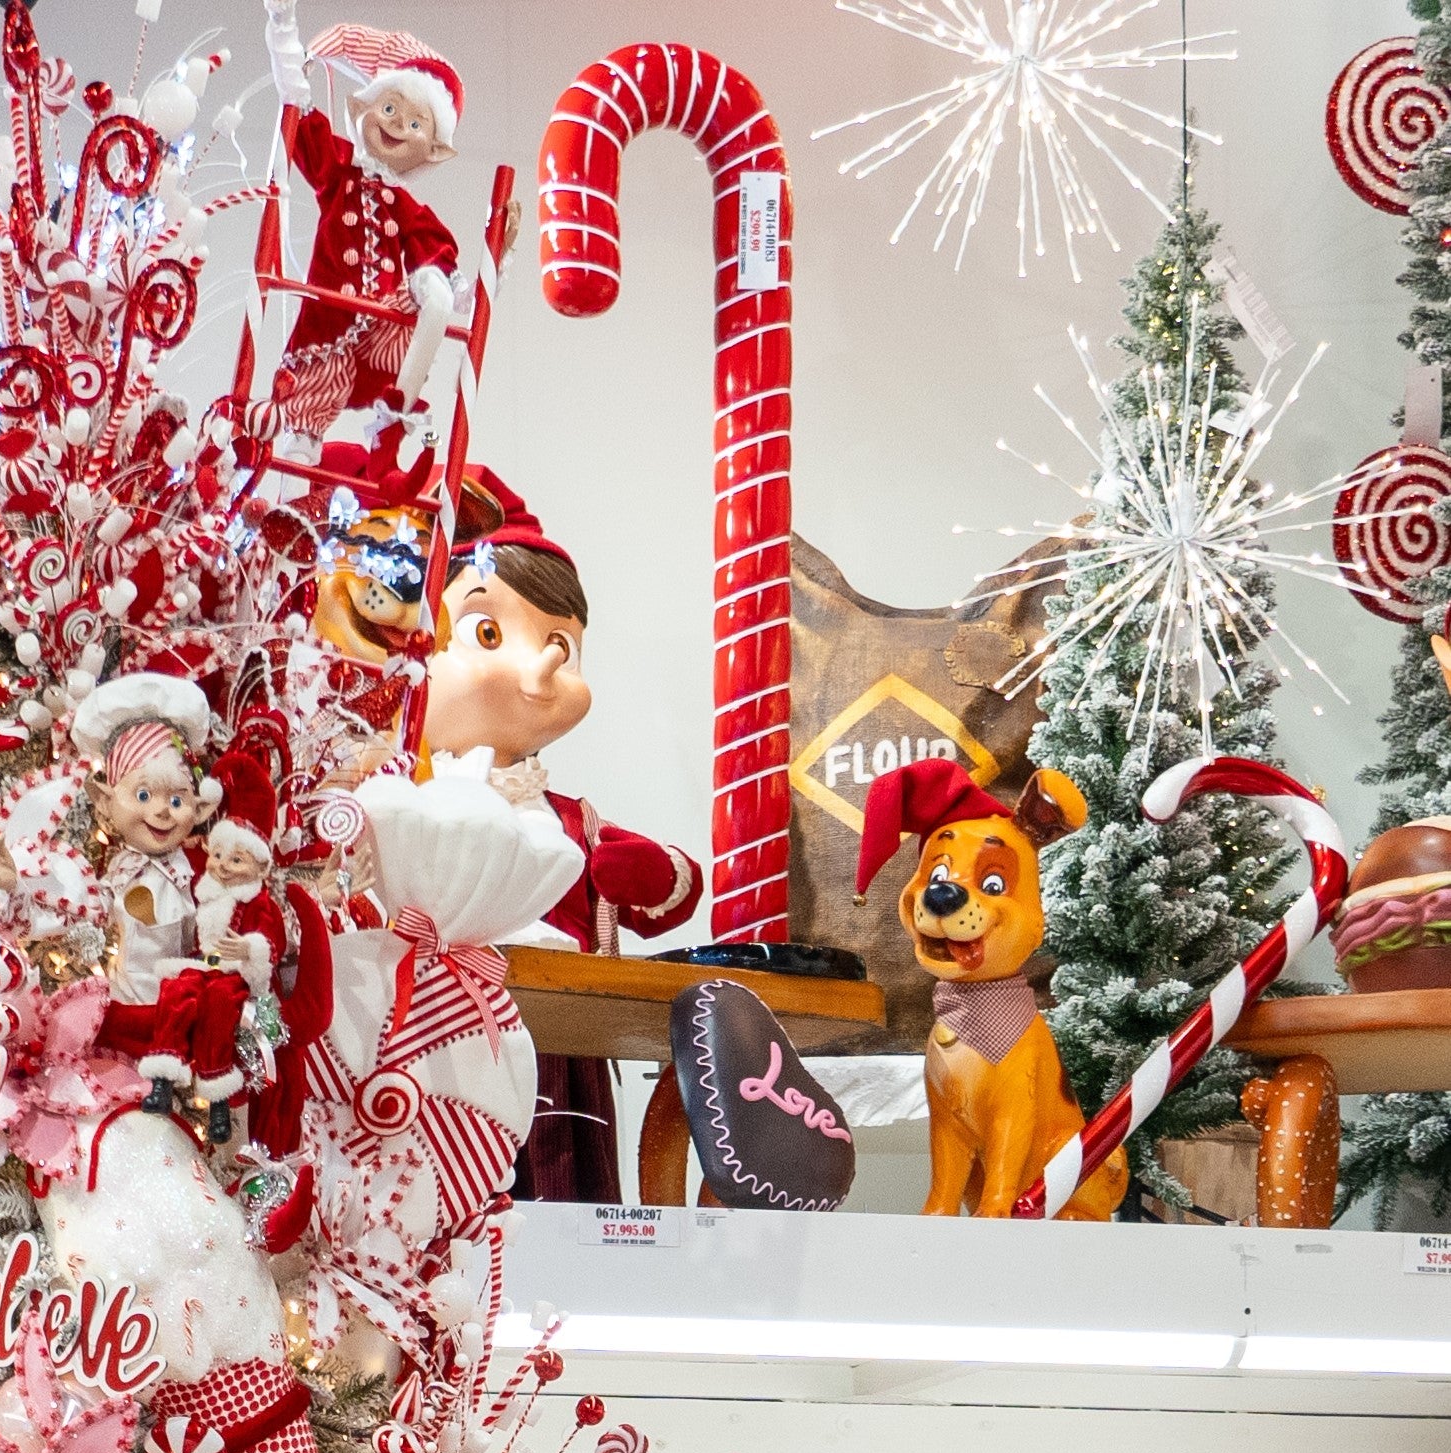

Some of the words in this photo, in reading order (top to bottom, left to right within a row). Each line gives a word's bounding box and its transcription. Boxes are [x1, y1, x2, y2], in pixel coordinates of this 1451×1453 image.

[750, 209, 761, 252] $299.99
[739, 1041, 852, 1144] Love
[595, 1207, 662, 1221] 06714-00207
[602, 1223, 655, 1237] $7,995.00
